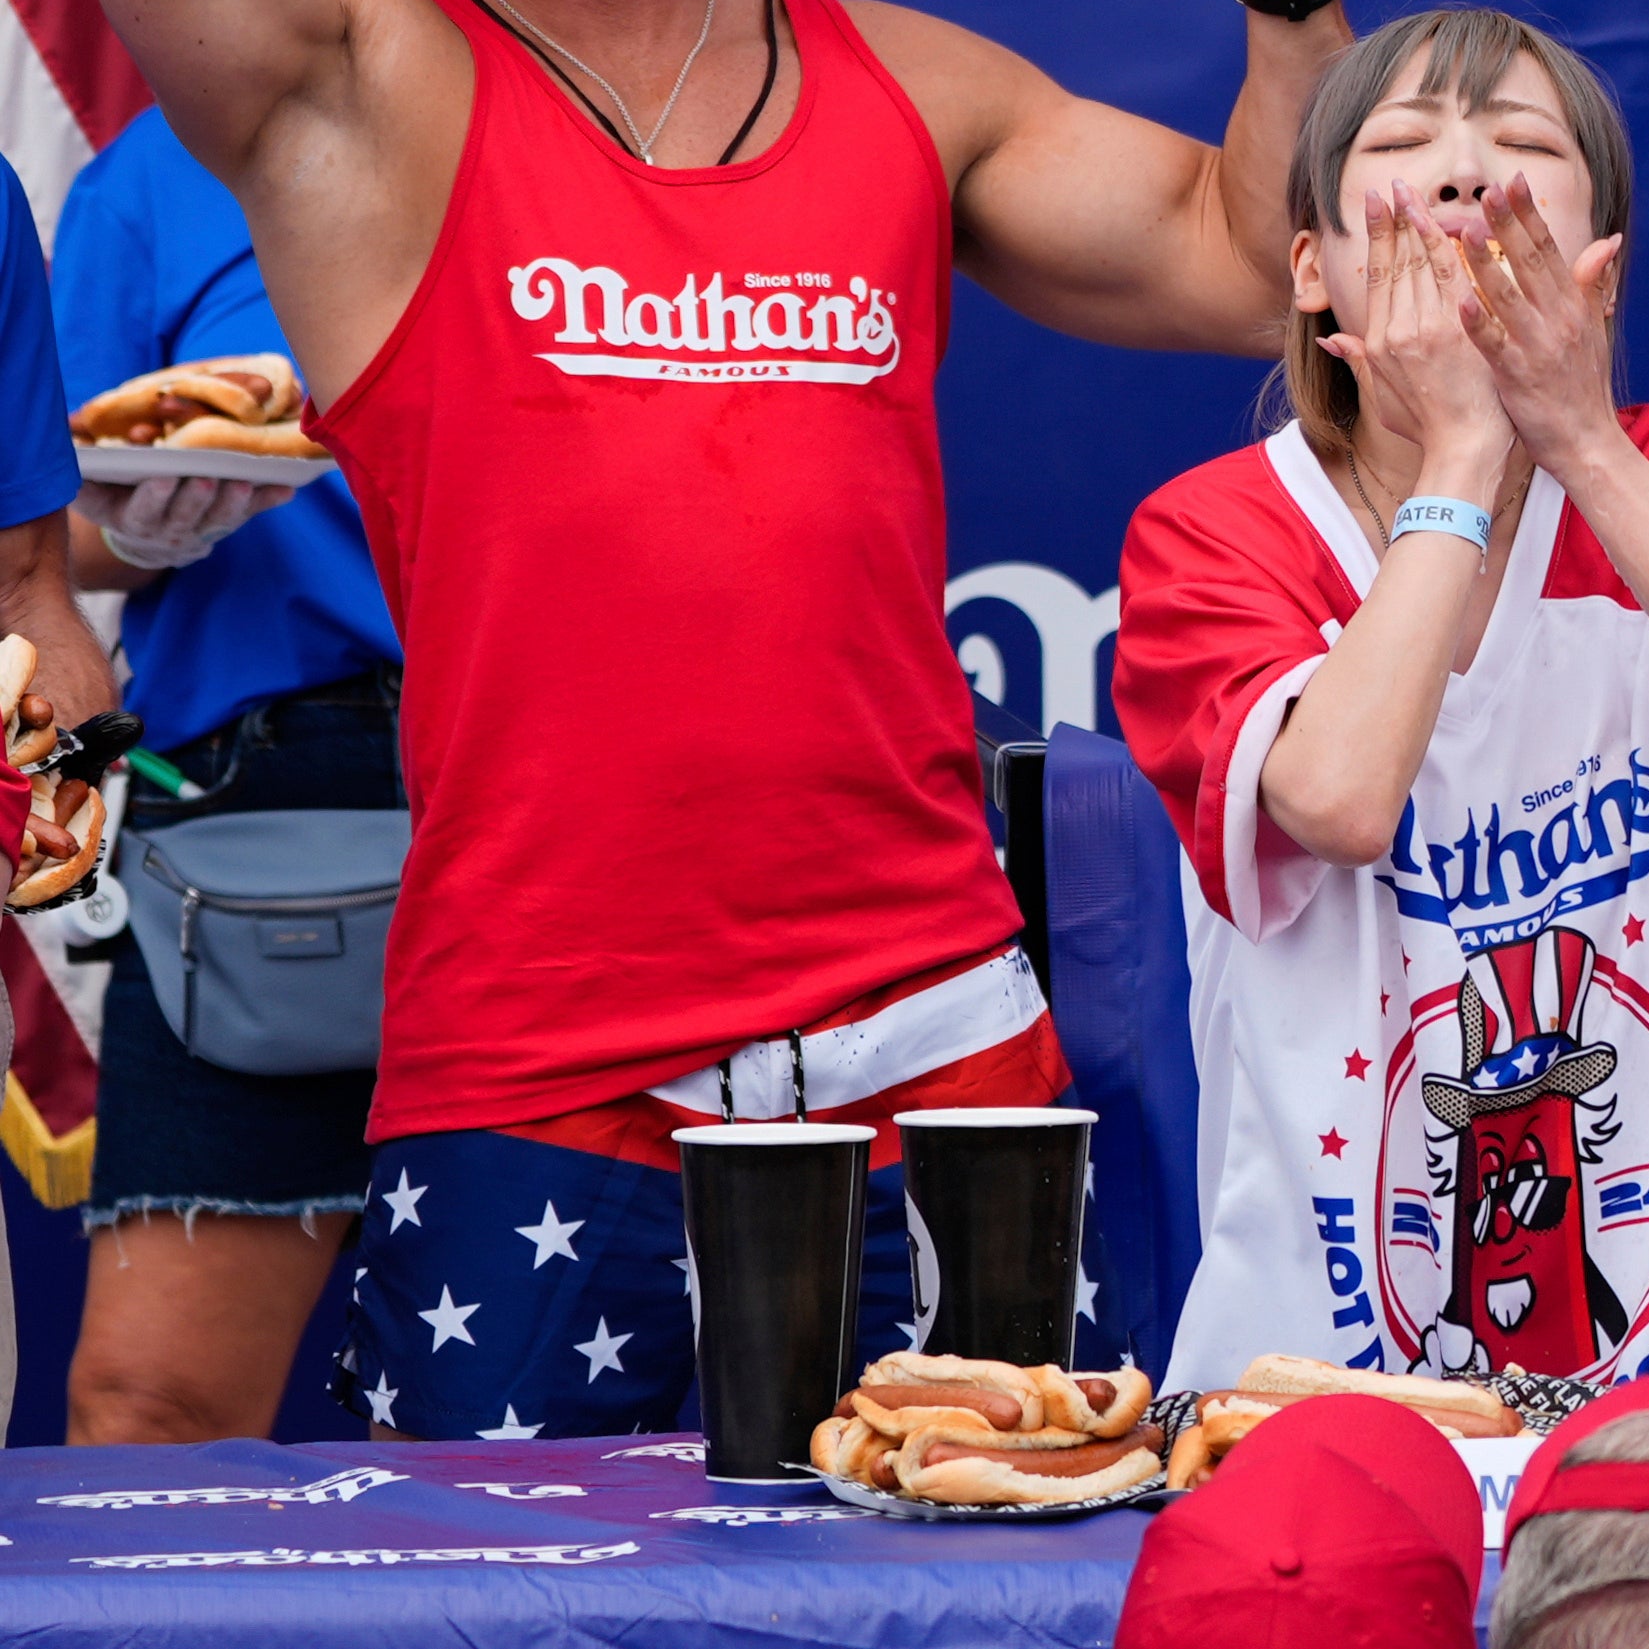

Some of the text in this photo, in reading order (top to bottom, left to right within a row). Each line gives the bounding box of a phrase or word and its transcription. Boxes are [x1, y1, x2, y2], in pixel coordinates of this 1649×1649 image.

[744, 272, 831, 288] Since 1916
[507, 257, 895, 355] Nathan's
[657, 364, 792, 378] FAMOUS
[1521, 777, 1574, 813] Since
[1311, 1196, 1375, 1329] HOT
